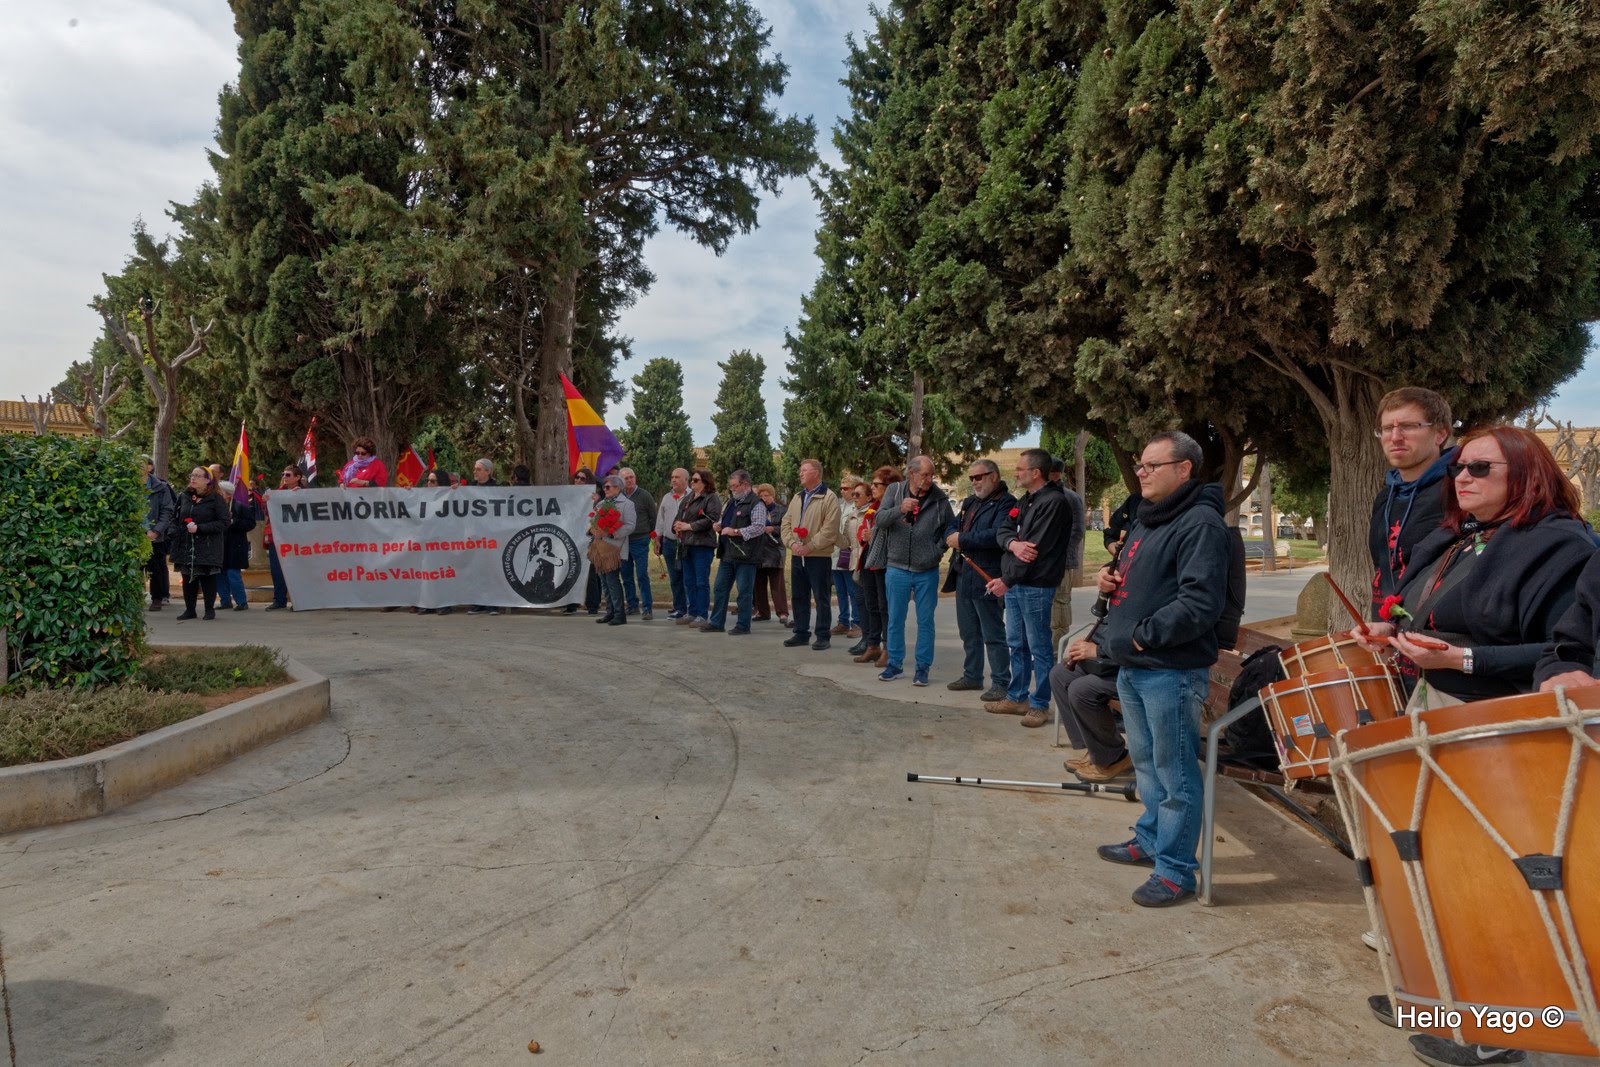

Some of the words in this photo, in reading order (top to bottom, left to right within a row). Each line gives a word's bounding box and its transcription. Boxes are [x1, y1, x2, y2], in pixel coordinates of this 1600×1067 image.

[281, 496, 411, 523] MEMÒRIA
[419, 501, 427, 519] I
[435, 494, 562, 518] JUSTÍCIA
[279, 541, 378, 557] Plataforma
[382, 543, 405, 555] per
[407, 540, 422, 551] la
[425, 537, 497, 551] memòria
[327, 568, 353, 582] del
[356, 565, 388, 581] País
[388, 565, 456, 581] Valencià
